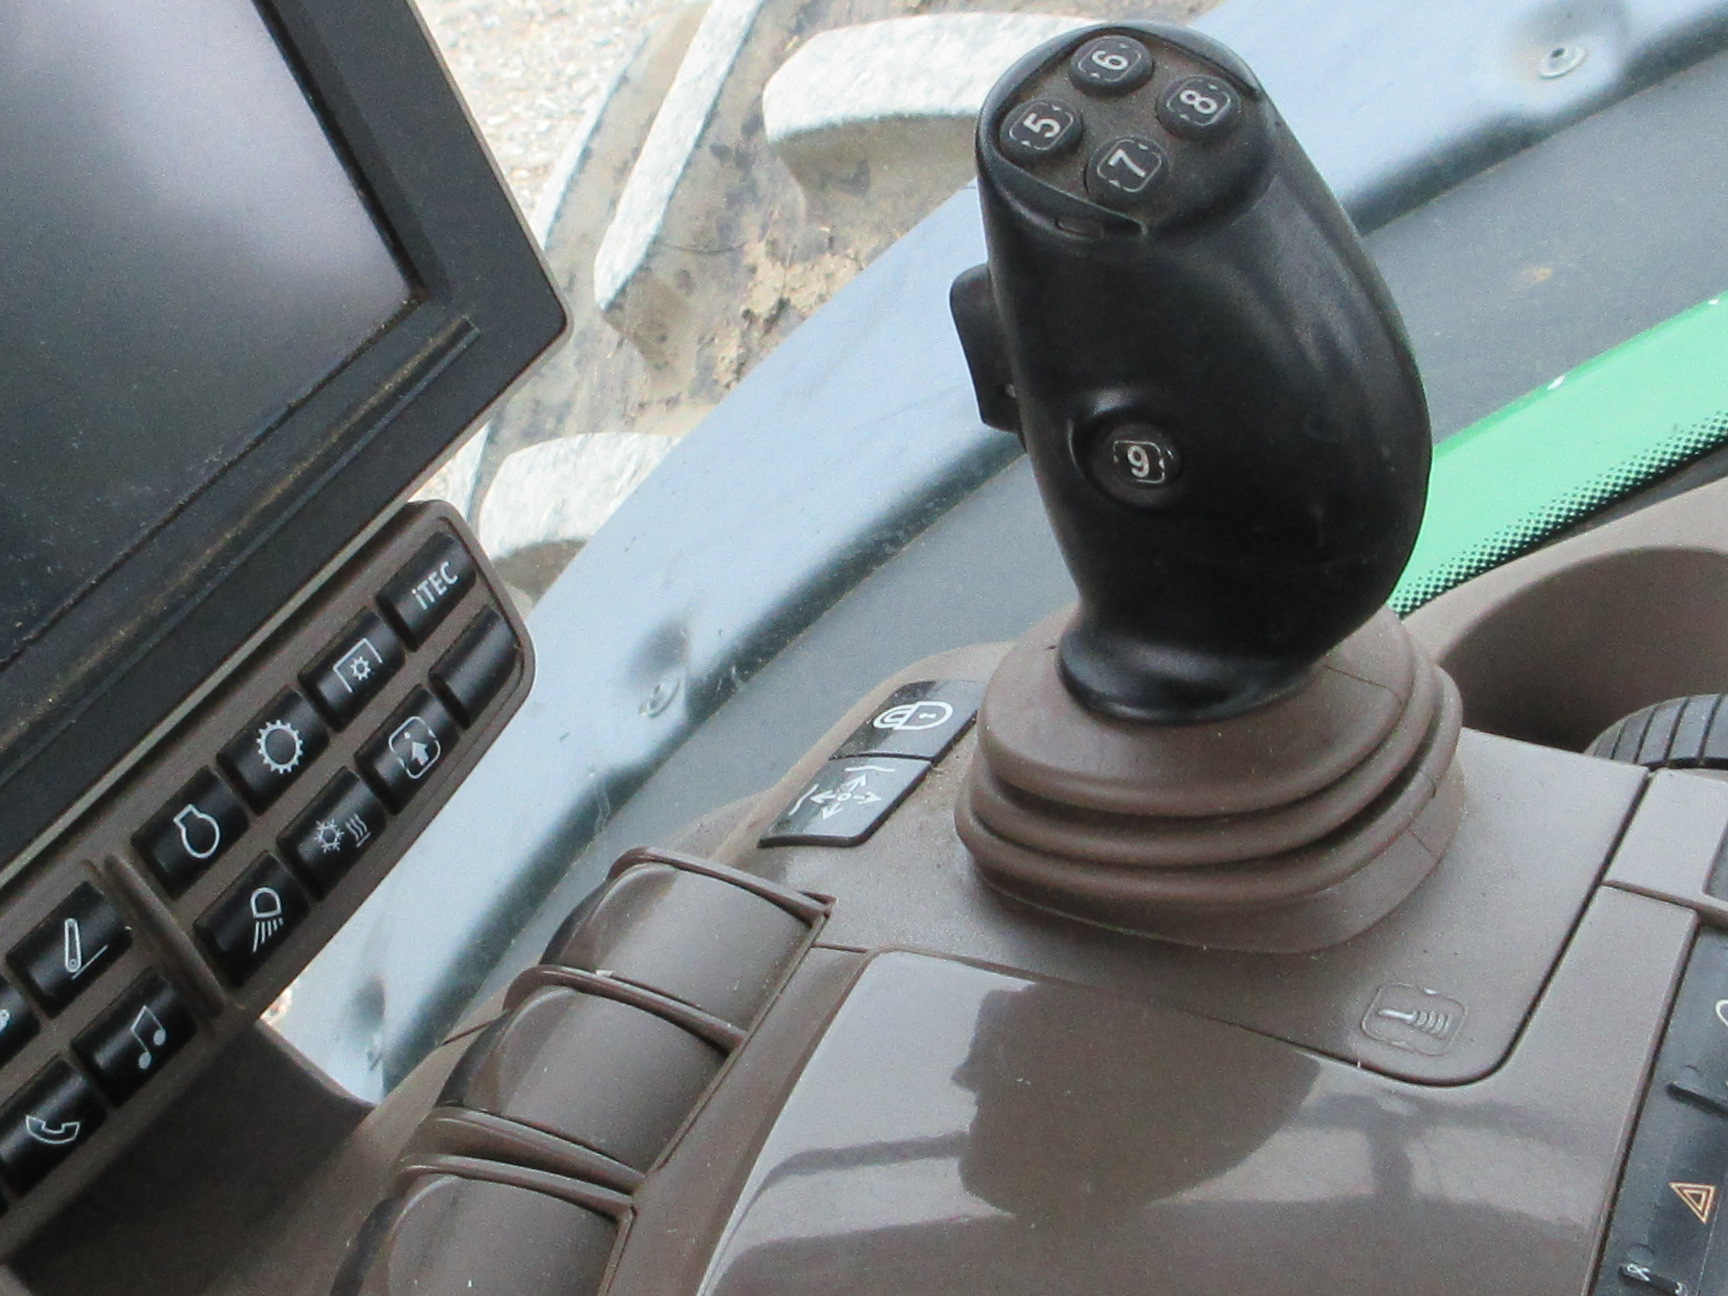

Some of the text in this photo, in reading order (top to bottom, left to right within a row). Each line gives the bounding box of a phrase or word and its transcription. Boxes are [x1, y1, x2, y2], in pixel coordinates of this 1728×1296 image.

[1090, 49, 1130, 71] 6
[1179, 88, 1219, 115] 8
[1021, 114, 1061, 140] 5
[1108, 149, 1148, 181] 7
[1126, 445, 1150, 479] 9
[411, 560, 459, 611] iTEC
